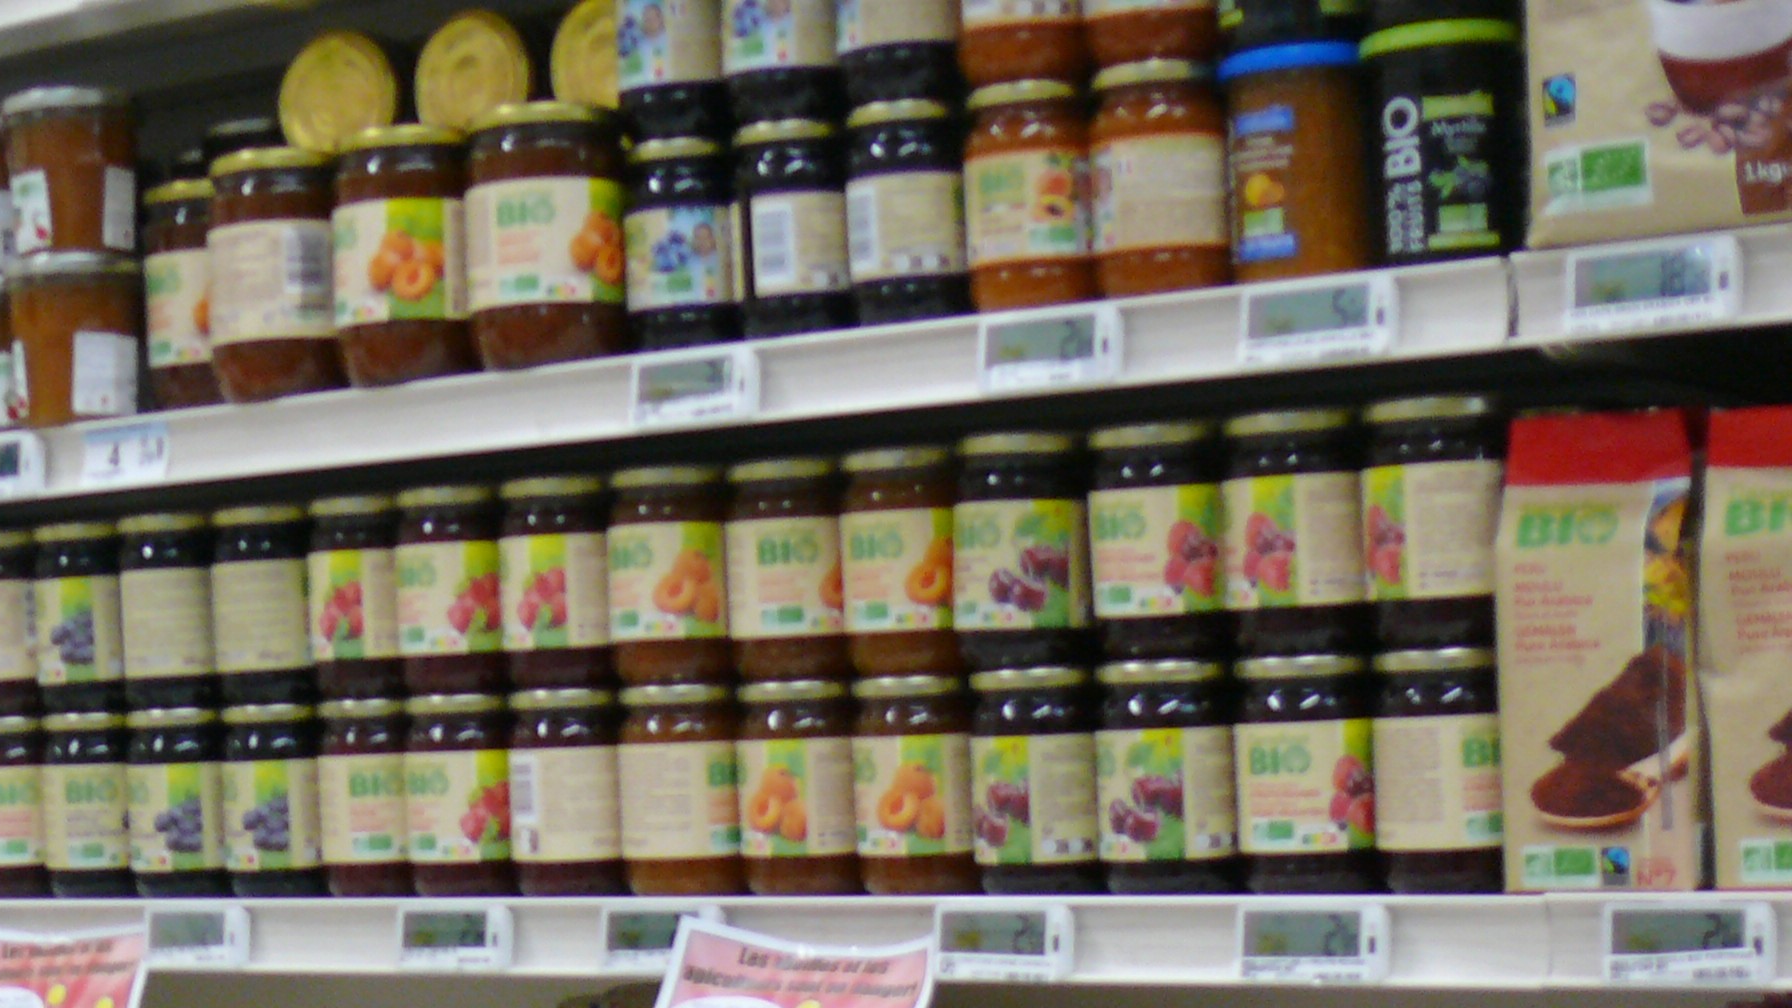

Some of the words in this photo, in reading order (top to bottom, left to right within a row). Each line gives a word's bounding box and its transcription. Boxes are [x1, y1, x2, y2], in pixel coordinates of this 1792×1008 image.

[1383, 96, 1422, 179] BIO
[497, 199, 556, 227] BIO
[1516, 510, 1619, 547] BIO
[758, 535, 819, 565] BIO
[1250, 744, 1312, 775] BIO
